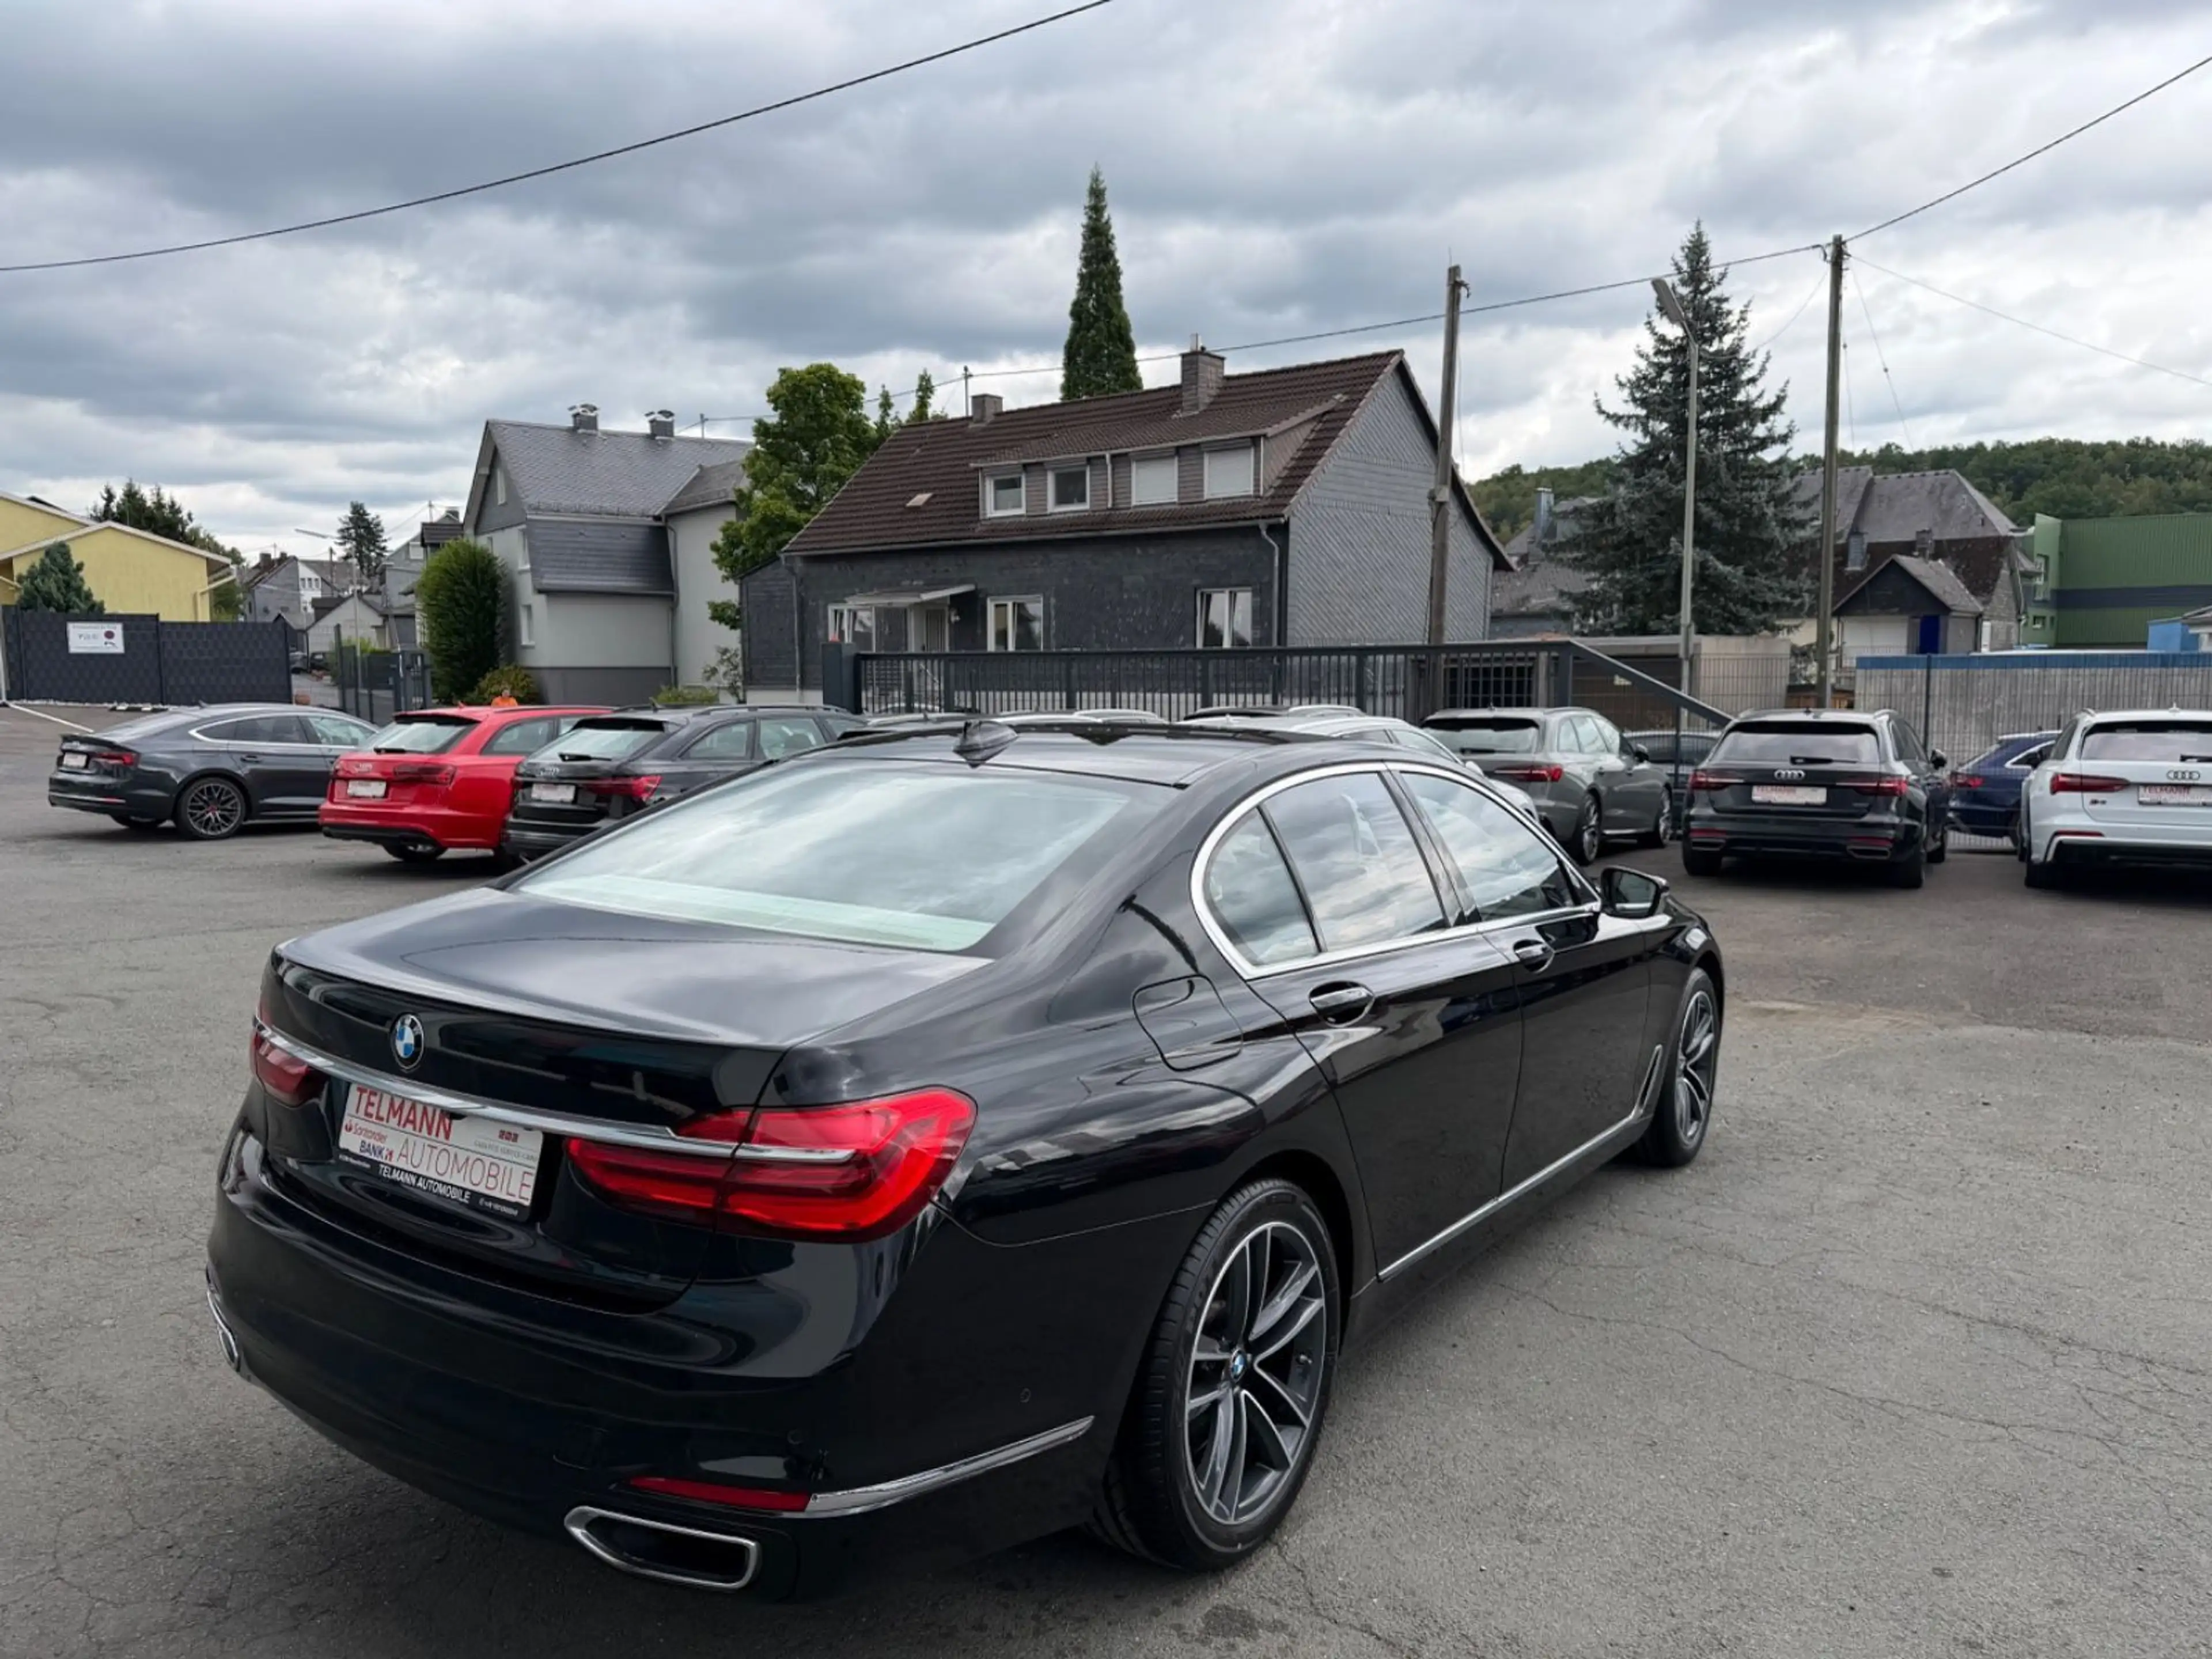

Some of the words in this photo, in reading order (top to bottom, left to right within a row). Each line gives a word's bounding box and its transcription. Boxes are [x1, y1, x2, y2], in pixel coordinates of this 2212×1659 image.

[355, 1086, 453, 1141] TELMANN
[378, 1164, 417, 1187] TELMANN
[416, 1177, 471, 1204] AUTOMOBILE
[397, 1137, 535, 1201] AUTOMOBILE
